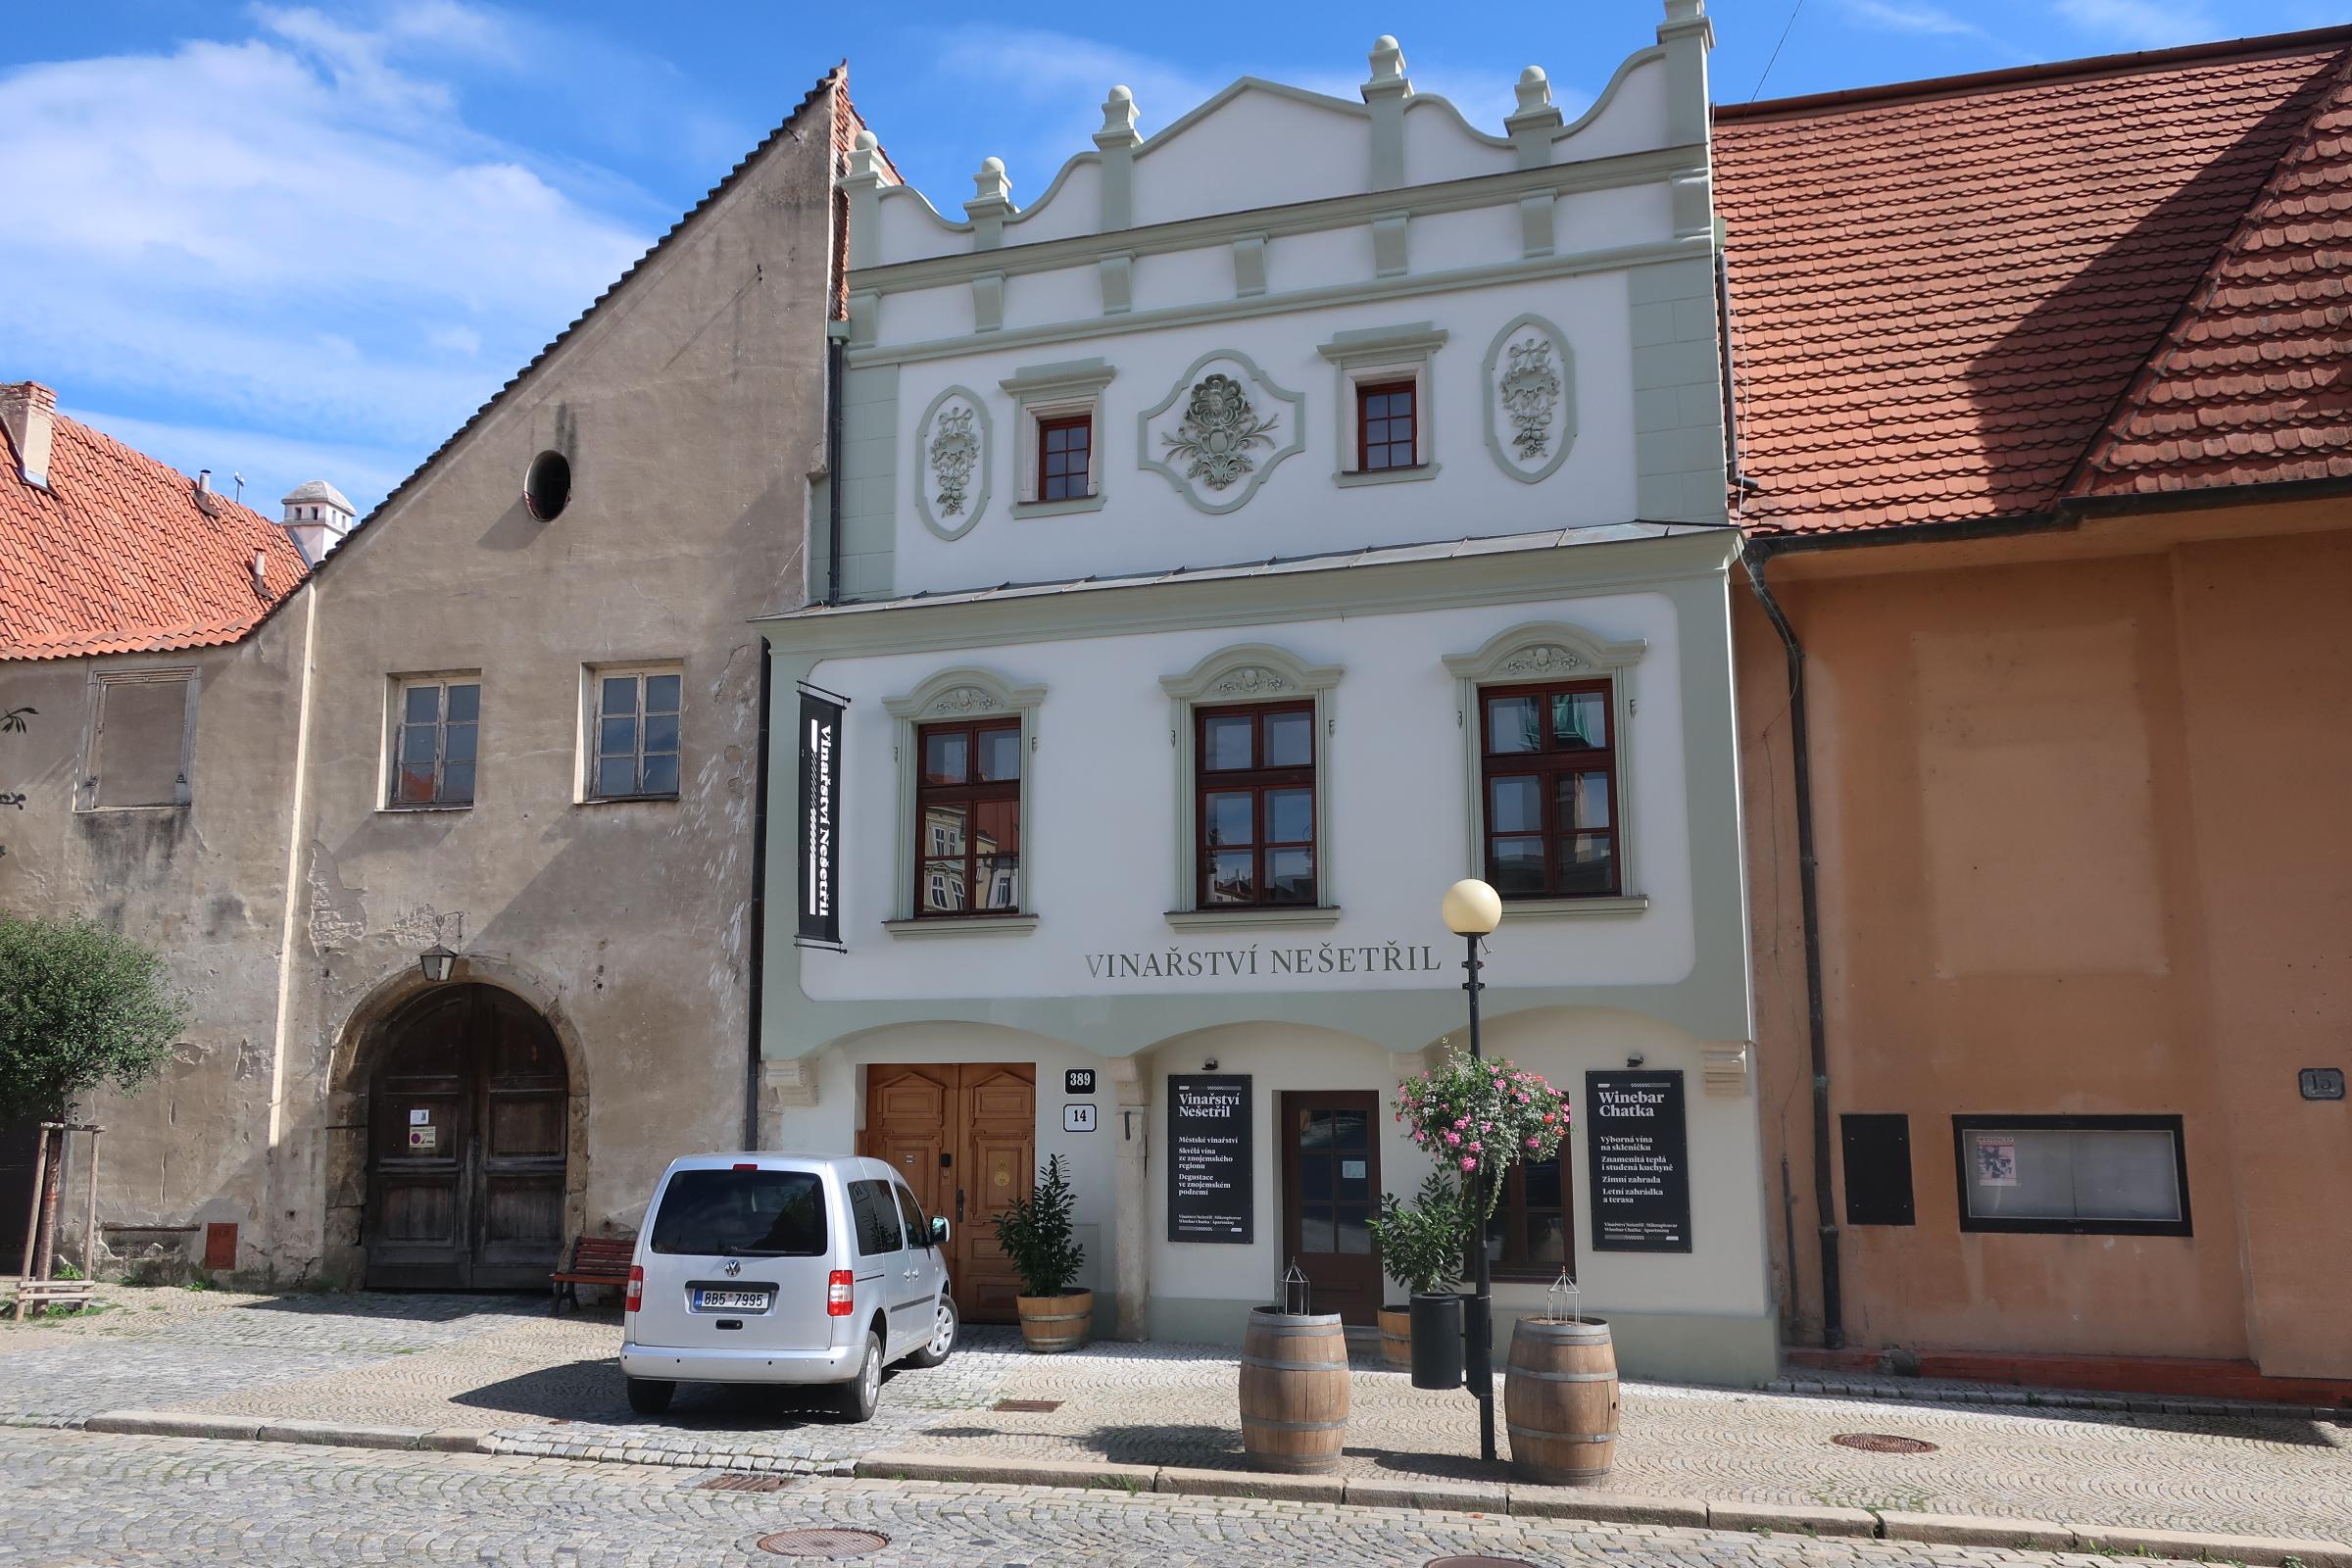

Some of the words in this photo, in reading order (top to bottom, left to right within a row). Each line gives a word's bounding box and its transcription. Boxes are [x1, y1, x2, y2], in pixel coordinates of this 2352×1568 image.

[819, 724, 832, 828] Vinařství
[819, 828, 831, 917] Nešetřil
[1084, 944, 1258, 979] VINAŘSTVÍ
[1270, 941, 1443, 974] NEŠETŘIL
[1070, 1072, 1091, 1086] 389
[1179, 1093, 1240, 1105] Vinařství
[1598, 1091, 1665, 1104] Winebar
[1073, 1109, 1087, 1122] 14
[1179, 1105, 1231, 1118] Nešetřil
[1599, 1103, 1655, 1117] Chatka
[1600, 1136, 1635, 1145] Výborná
[1179, 1162, 1205, 1171] regionu
[1645, 1155, 1667, 1165] teplá
[1639, 1163, 1674, 1173] kuchyně
[1602, 1187, 1625, 1196] Letní
[705, 1292, 726, 1305] 8B5
[734, 1293, 763, 1307] 7995
